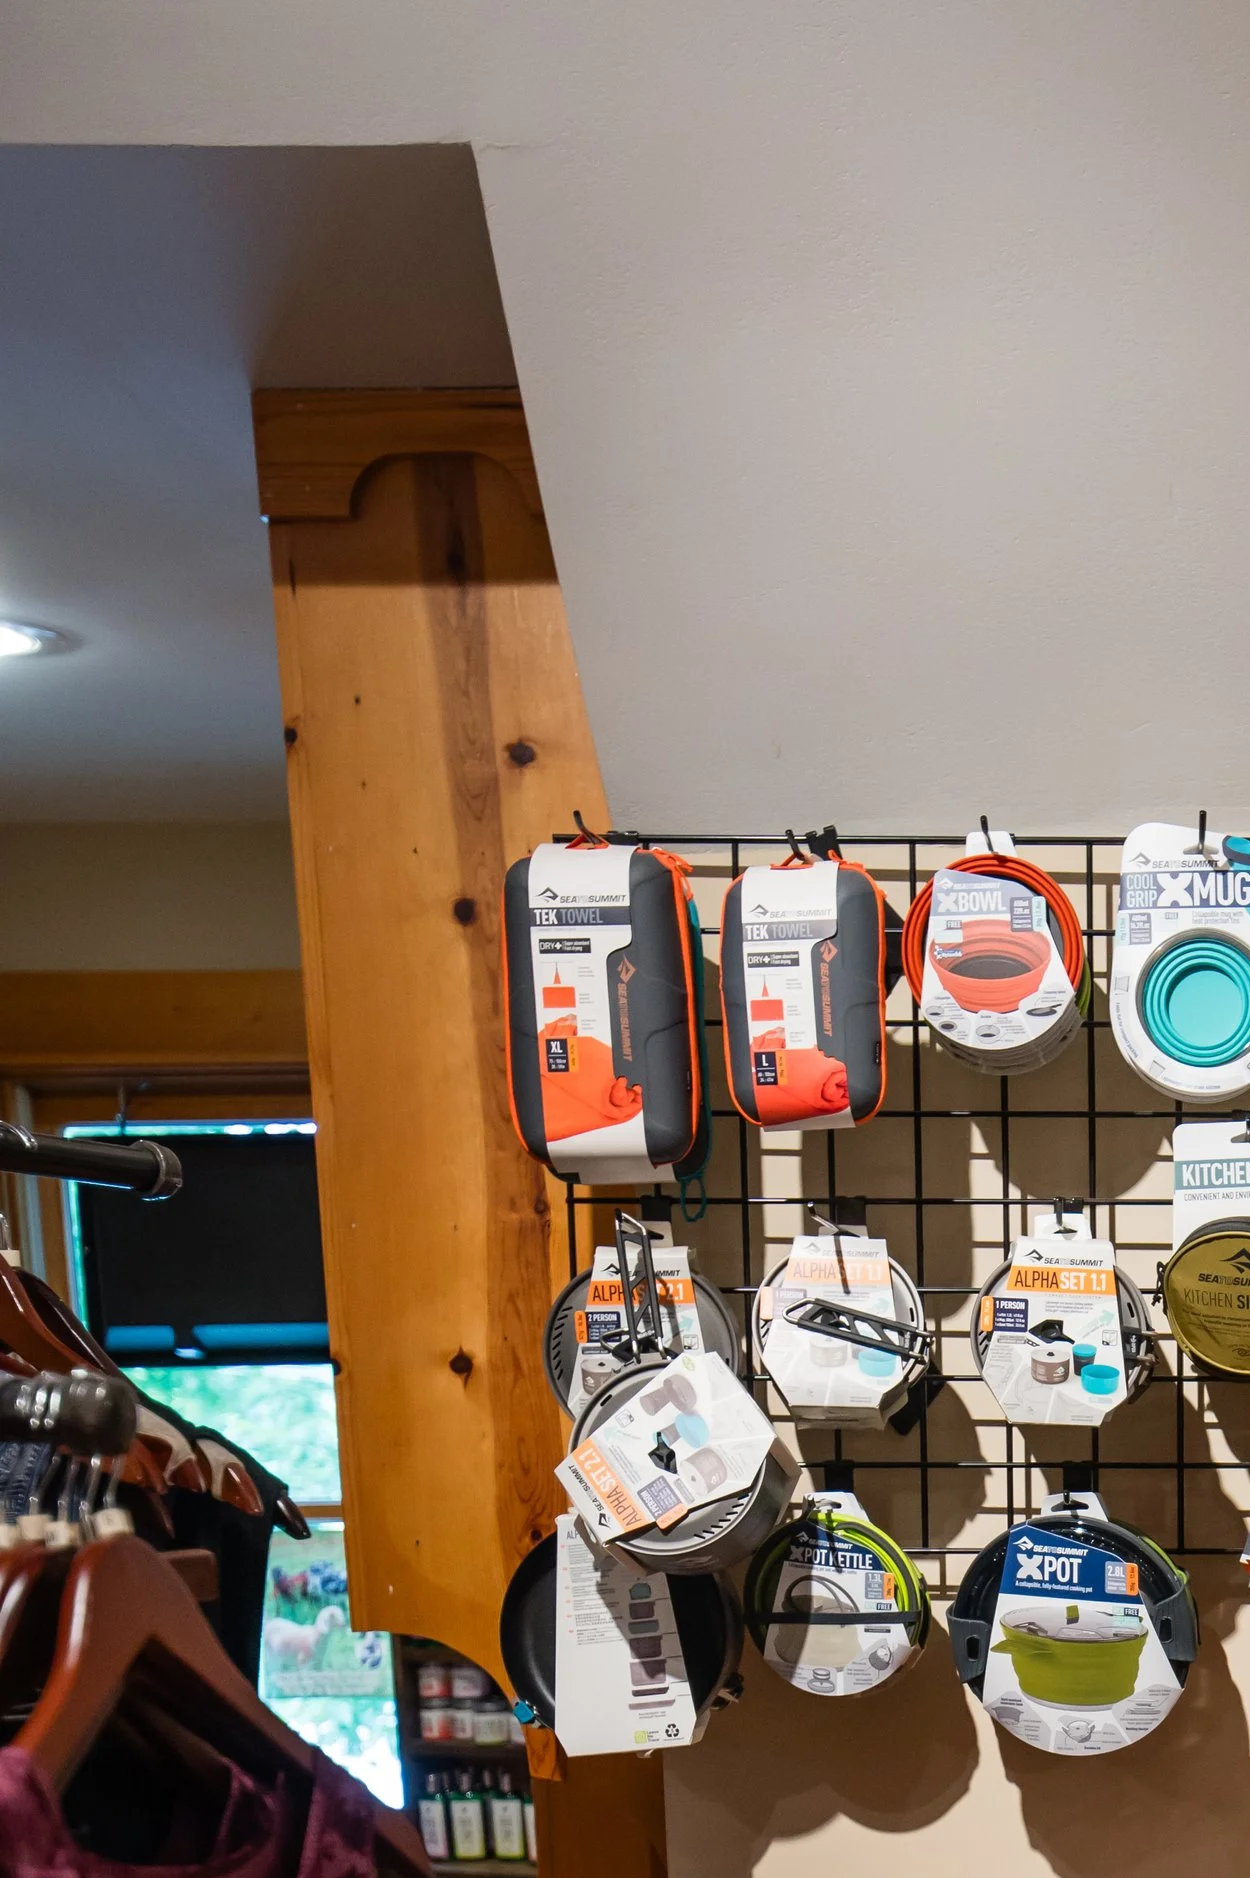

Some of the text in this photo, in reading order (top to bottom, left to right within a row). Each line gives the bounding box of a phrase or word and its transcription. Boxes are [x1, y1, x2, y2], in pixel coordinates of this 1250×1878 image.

[1126, 873, 1157, 890] COOL
[1126, 892, 1158, 908] GRIP
[534, 908, 605, 925] TEK TOWEL
[745, 922, 813, 941] TEK TOWEL
[550, 1040, 563, 1054] XL
[762, 1054, 769, 1067] L
[1183, 1192, 1225, 1202] CONVENIENT
[1225, 1191, 1235, 1201] AND
[793, 1261, 837, 1279] ALPHA
[1014, 1269, 1107, 1291] ALPHA SET 1.1
[996, 1300, 1025, 1310] 1 PERSON
[1183, 1288, 1233, 1308] KITCHEN
[593, 1314, 618, 1322] PERSON
[590, 1465, 616, 1493] SET
[606, 1485, 643, 1528] ALPHA
[829, 1549, 873, 1569] KETTLE
[867, 1573, 882, 1583] 1.3L
[1107, 1565, 1126, 1578] 2.8L
[877, 1603, 892, 1611] FREE
[1124, 1608, 1139, 1616] FREE
